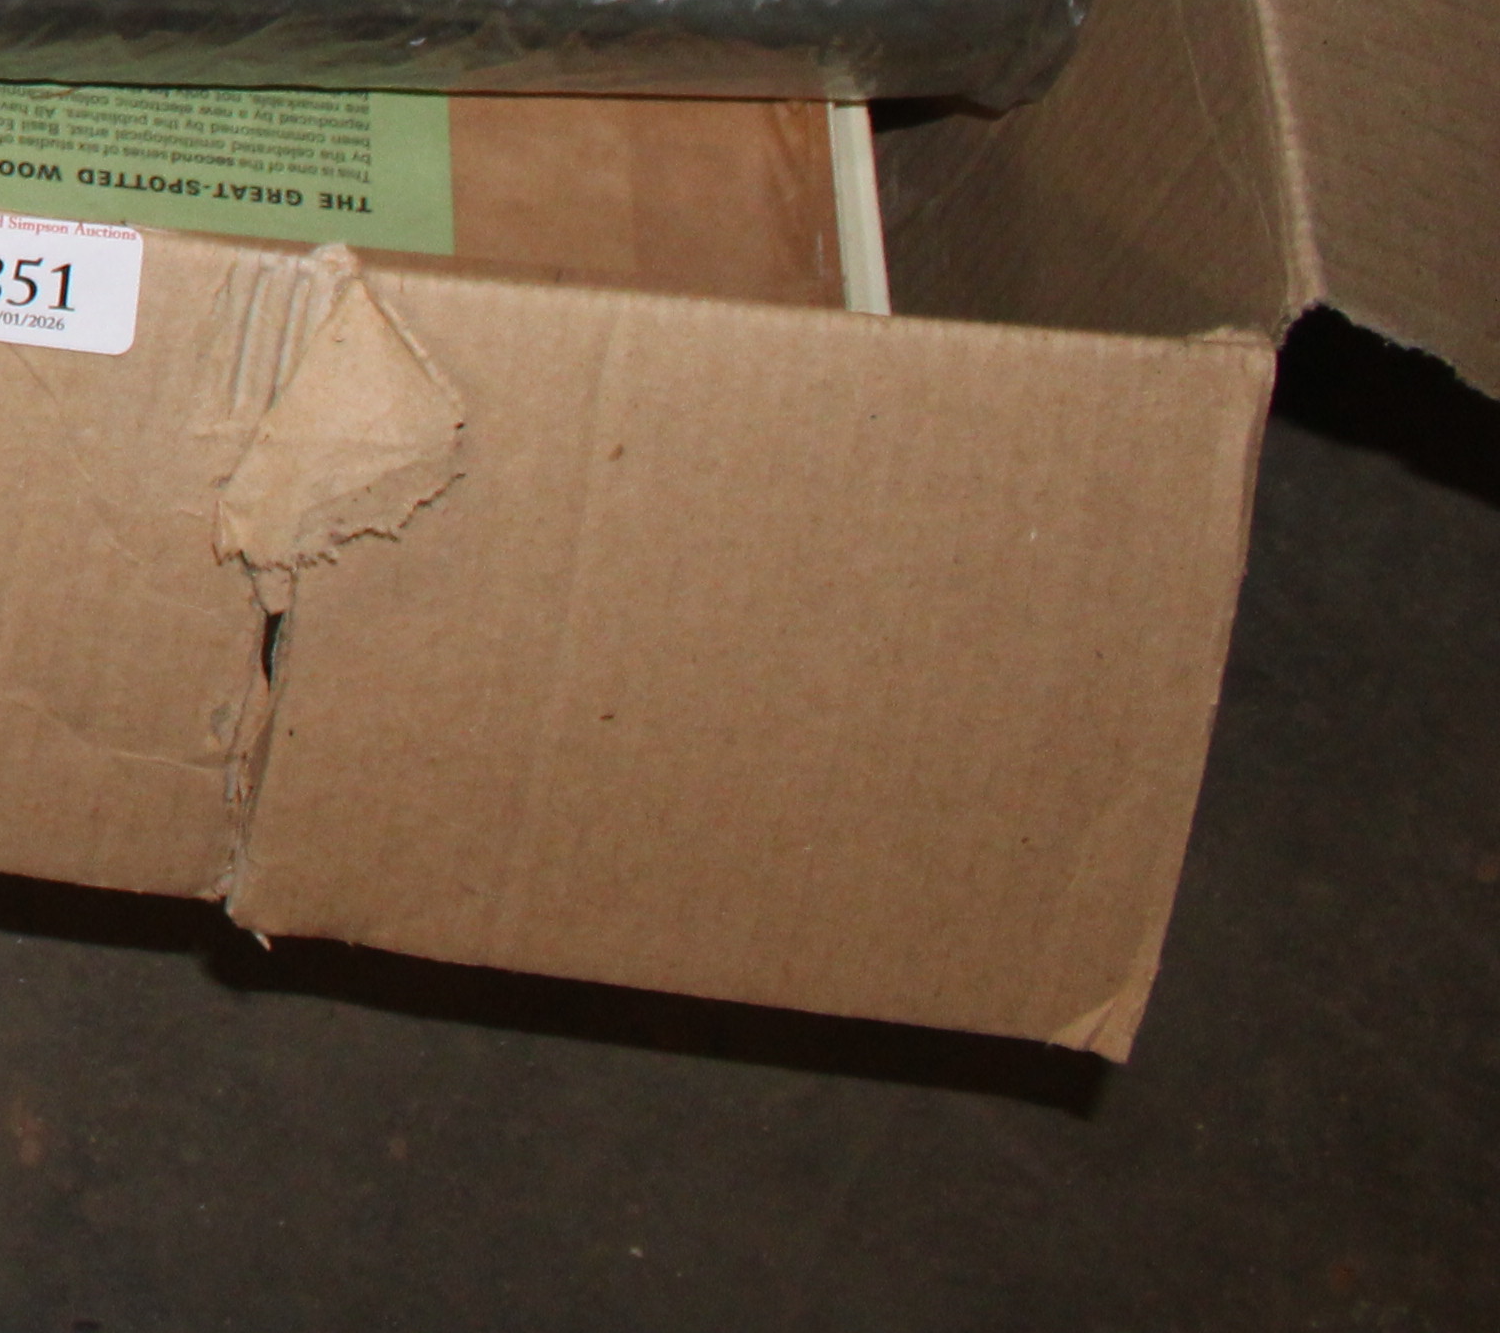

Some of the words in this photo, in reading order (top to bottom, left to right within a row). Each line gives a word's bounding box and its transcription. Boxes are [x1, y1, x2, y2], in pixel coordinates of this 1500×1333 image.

[208, 121, 326, 146] commissioned
[16, 135, 74, 152] studies
[230, 140, 315, 161] celebrated
[122, 147, 168, 161] series
[169, 152, 235, 168] second
[318, 149, 346, 164] the
[286, 163, 318, 174] one
[77, 168, 303, 206] GREAT-SPOTTED
[318, 191, 372, 214] THE
[7, 215, 69, 236] Simpson
[73, 222, 138, 241] Auctions
